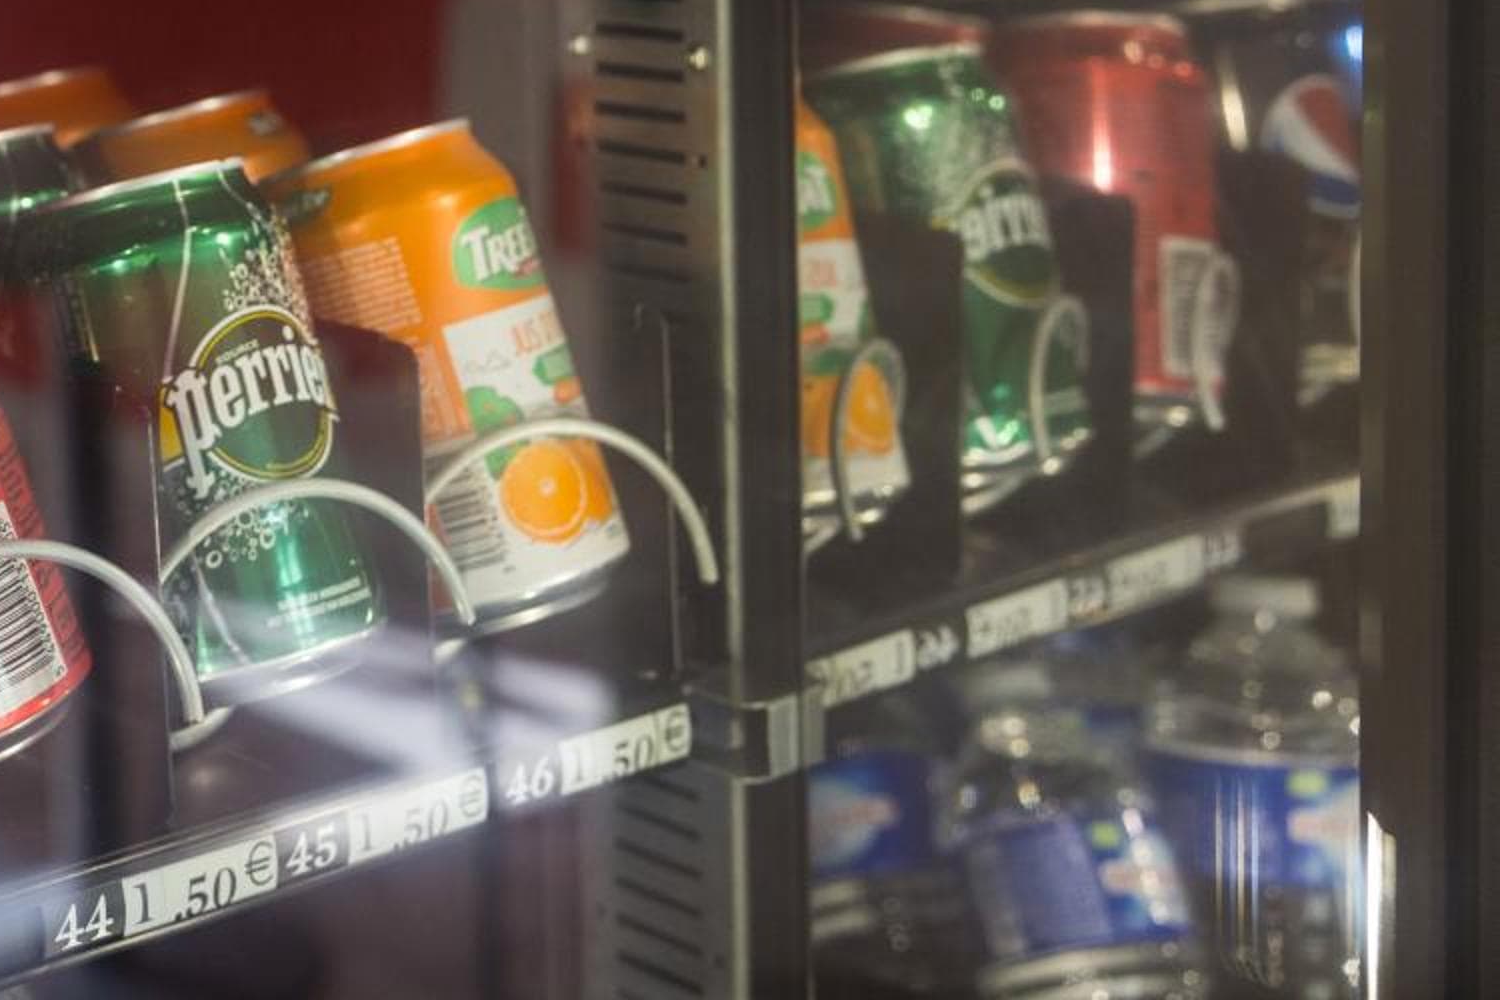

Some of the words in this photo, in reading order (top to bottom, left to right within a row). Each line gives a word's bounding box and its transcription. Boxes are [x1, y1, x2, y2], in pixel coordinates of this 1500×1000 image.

[505, 755, 554, 806] 46
[286, 825, 338, 876] 45
[53, 894, 114, 951] 44
